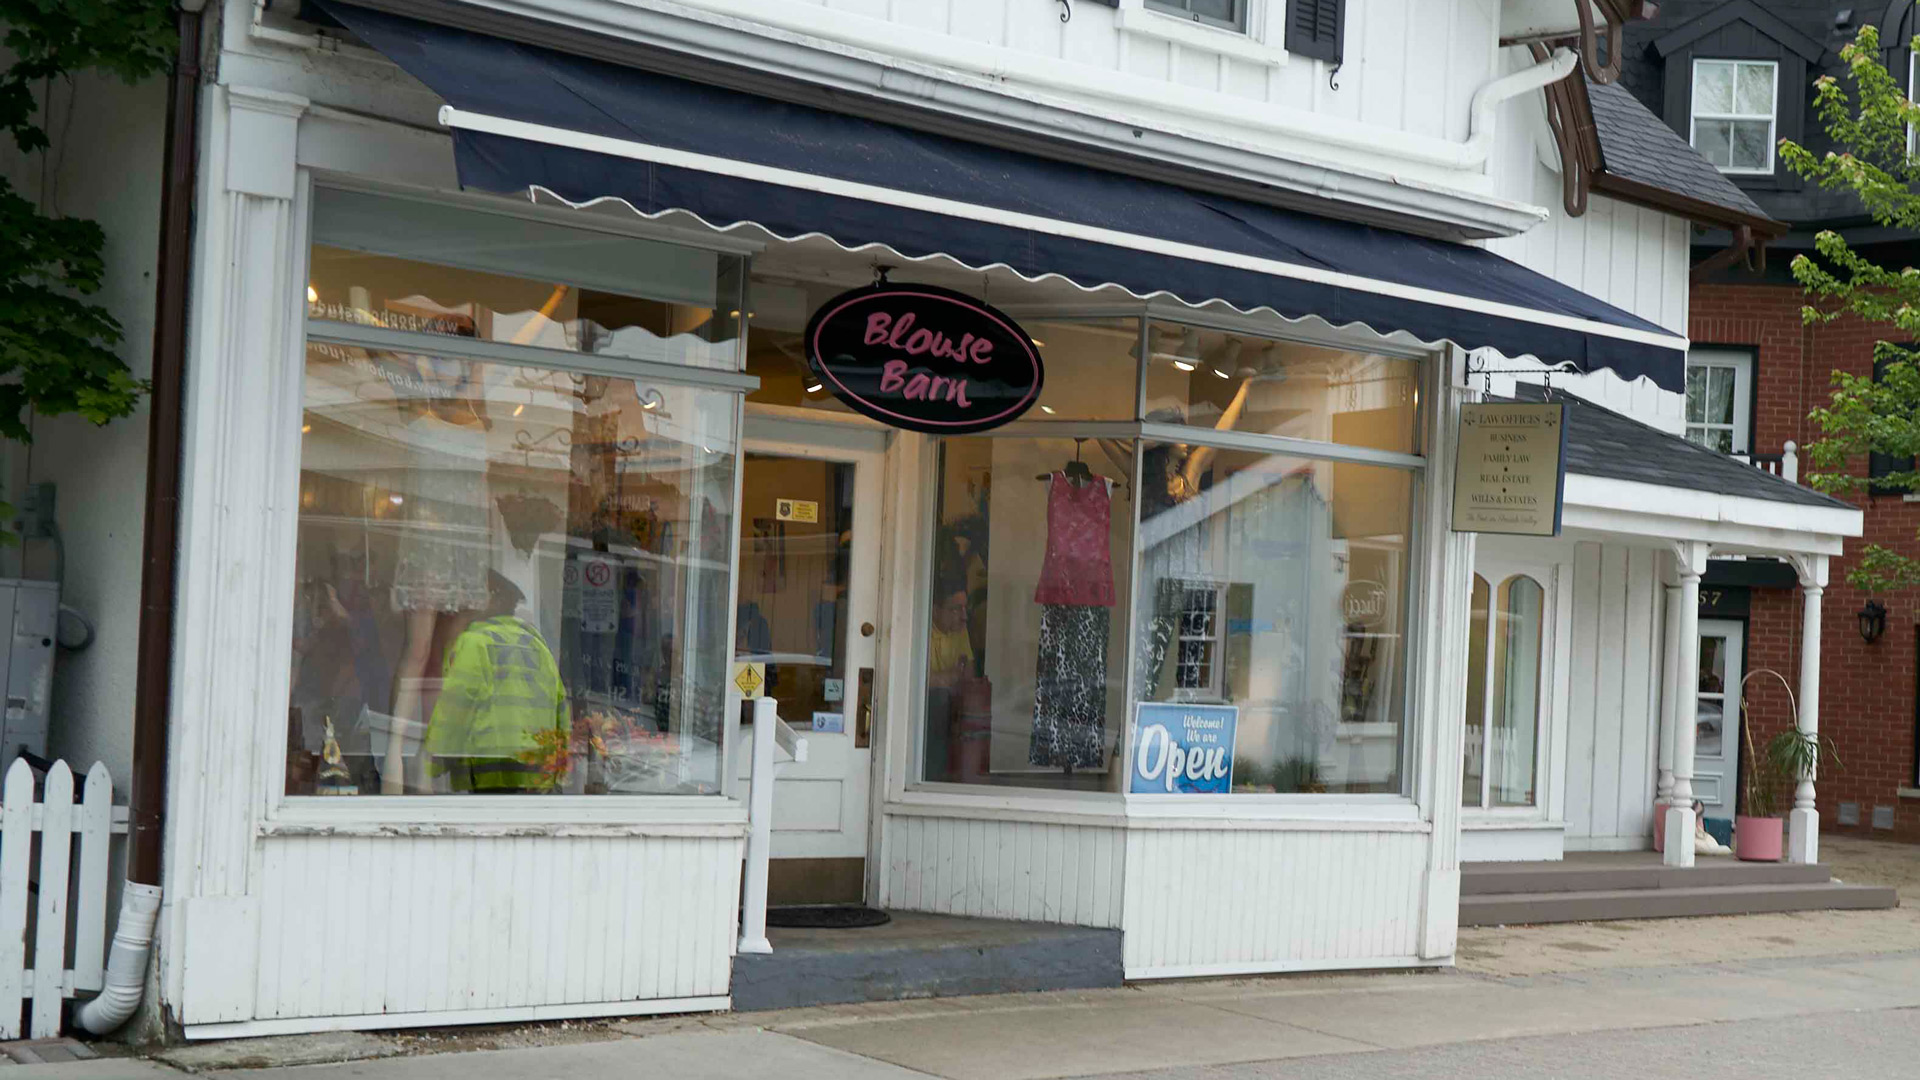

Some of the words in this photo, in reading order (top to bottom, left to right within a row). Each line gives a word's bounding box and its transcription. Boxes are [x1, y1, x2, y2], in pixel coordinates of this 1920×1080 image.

[864, 311, 994, 364] Blouse
[879, 359, 972, 408] Barn
[1479, 414, 1499, 424] LAW
[1501, 414, 1540, 425] OFFICES
[1490, 434, 1527, 442] BUSINESS
[1483, 454, 1511, 463] FAMILY
[1513, 454, 1530, 463] LAW
[1480, 474, 1500, 483] REAL
[1502, 475, 1530, 484] ESTATE
[1471, 494, 1495, 503] WILLS
[1503, 495, 1537, 505] ESTATES
[1183, 715, 1224, 730] Welcome!
[1186, 729, 1201, 743] We
[1202, 734, 1218, 743] are
[1137, 723, 1228, 792] Open
